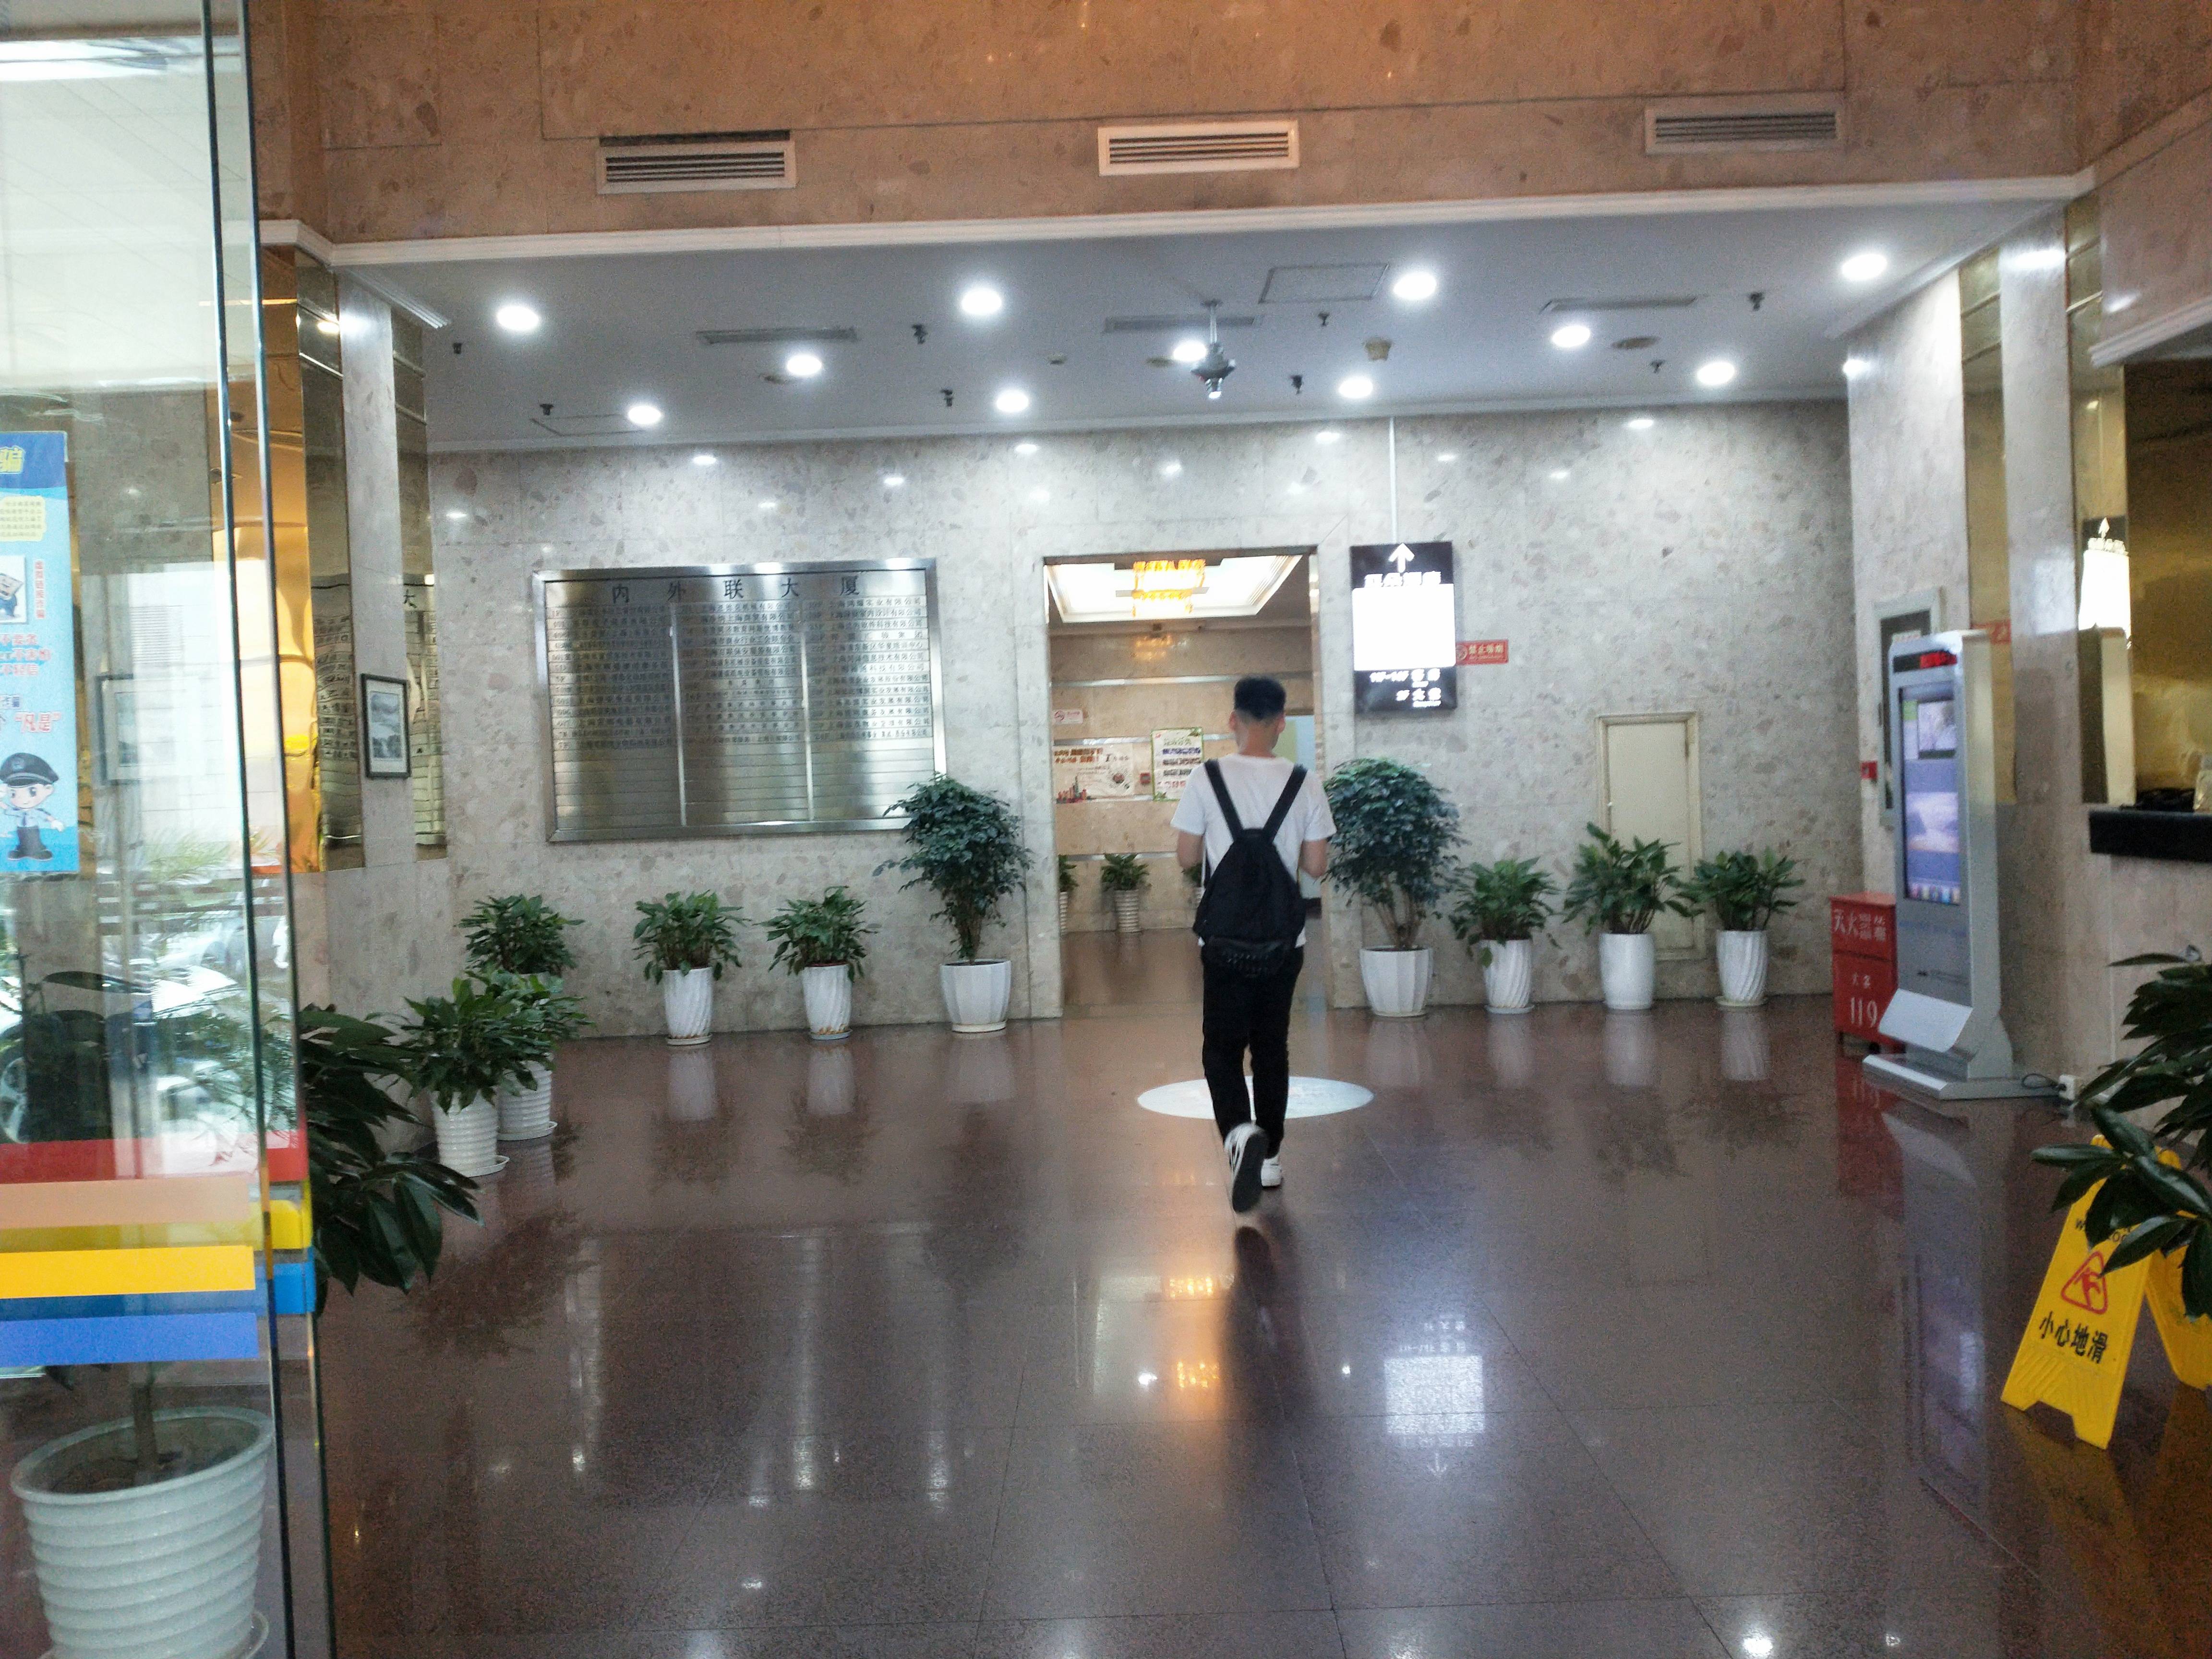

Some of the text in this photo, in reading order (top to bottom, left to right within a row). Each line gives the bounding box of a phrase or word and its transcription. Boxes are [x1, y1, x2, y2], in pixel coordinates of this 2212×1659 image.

[612, 576, 860, 602] 内外联大厦
[1850, 997, 1878, 1028] 119
[2039, 1311, 2108, 1363] 小心地滑
